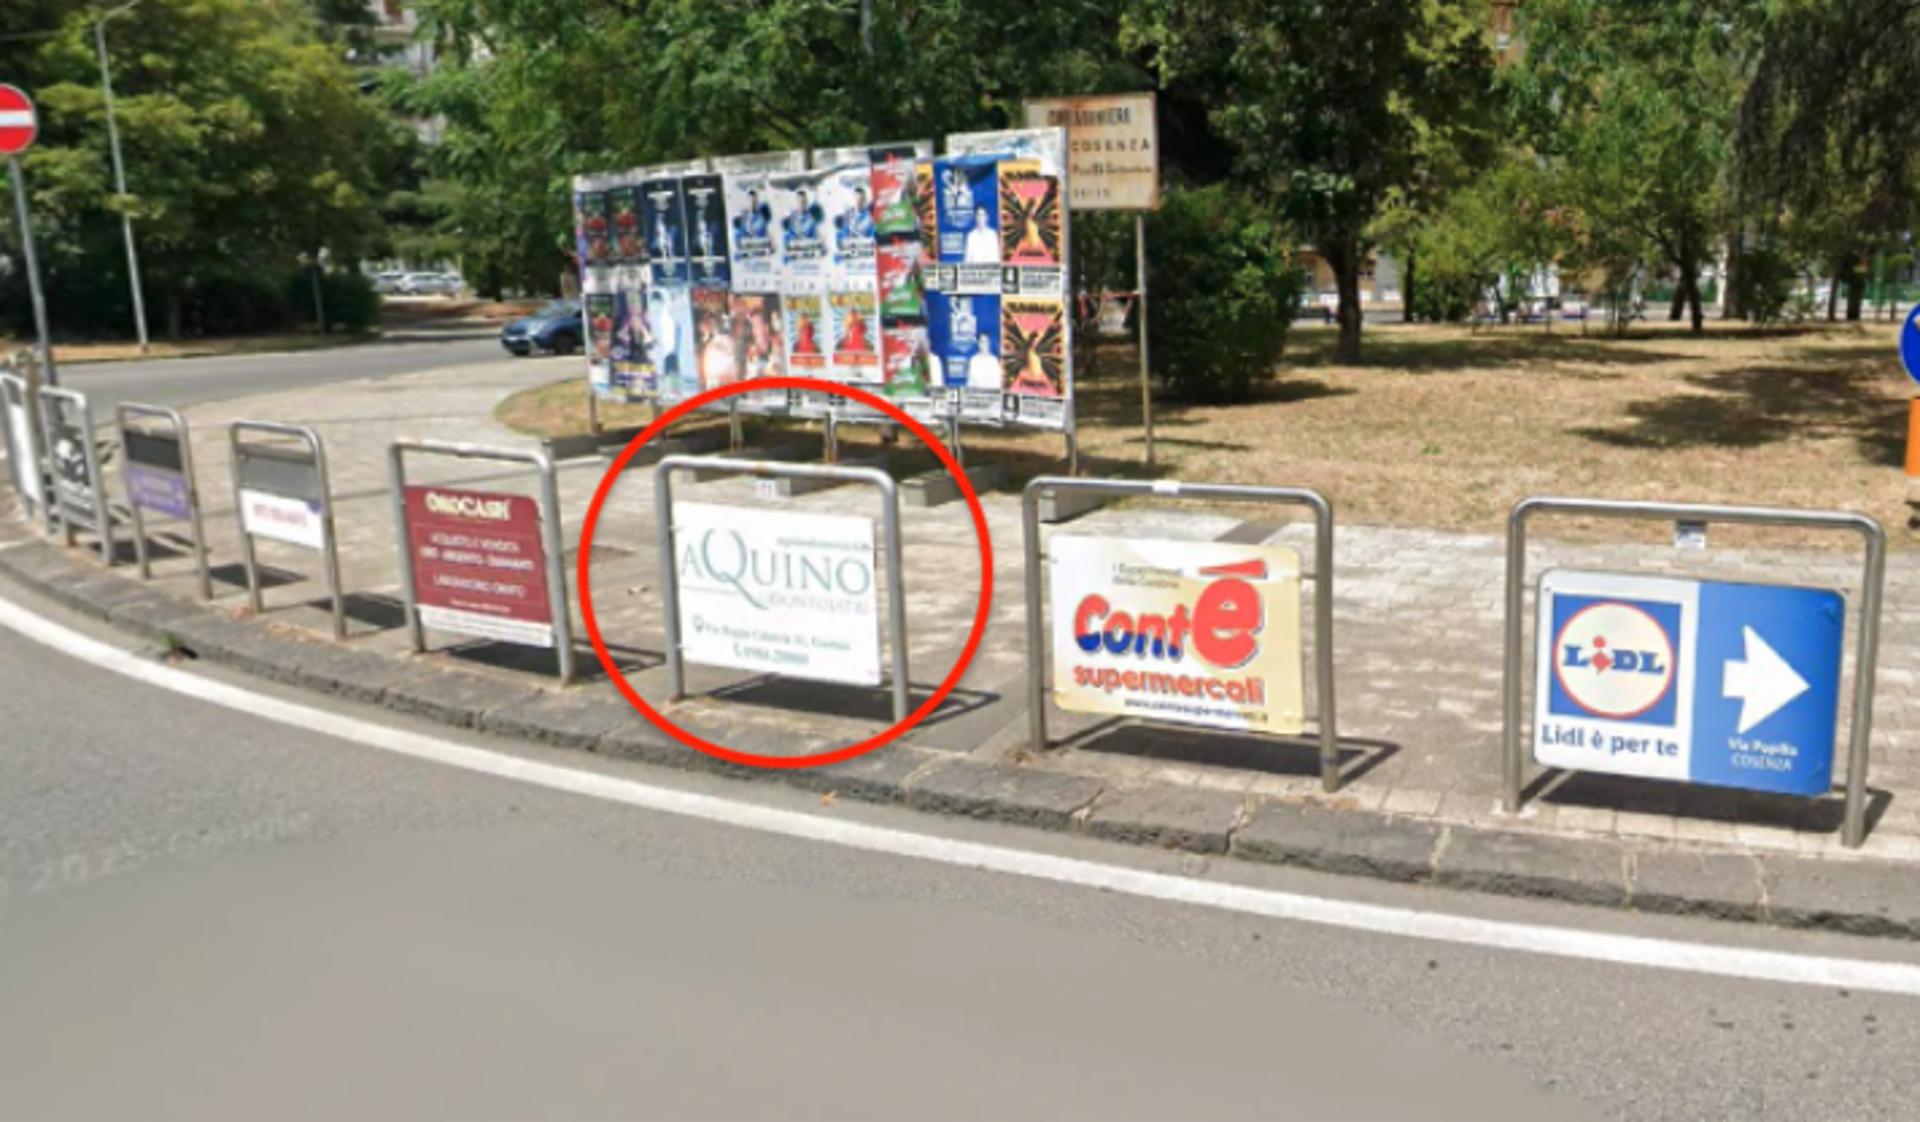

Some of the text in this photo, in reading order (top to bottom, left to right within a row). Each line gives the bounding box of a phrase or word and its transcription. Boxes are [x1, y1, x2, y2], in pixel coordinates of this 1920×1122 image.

[1071, 137, 1151, 153] COSENZA
[681, 528, 871, 609] AQUINO
[1541, 724, 1680, 757] Lidl è per te
